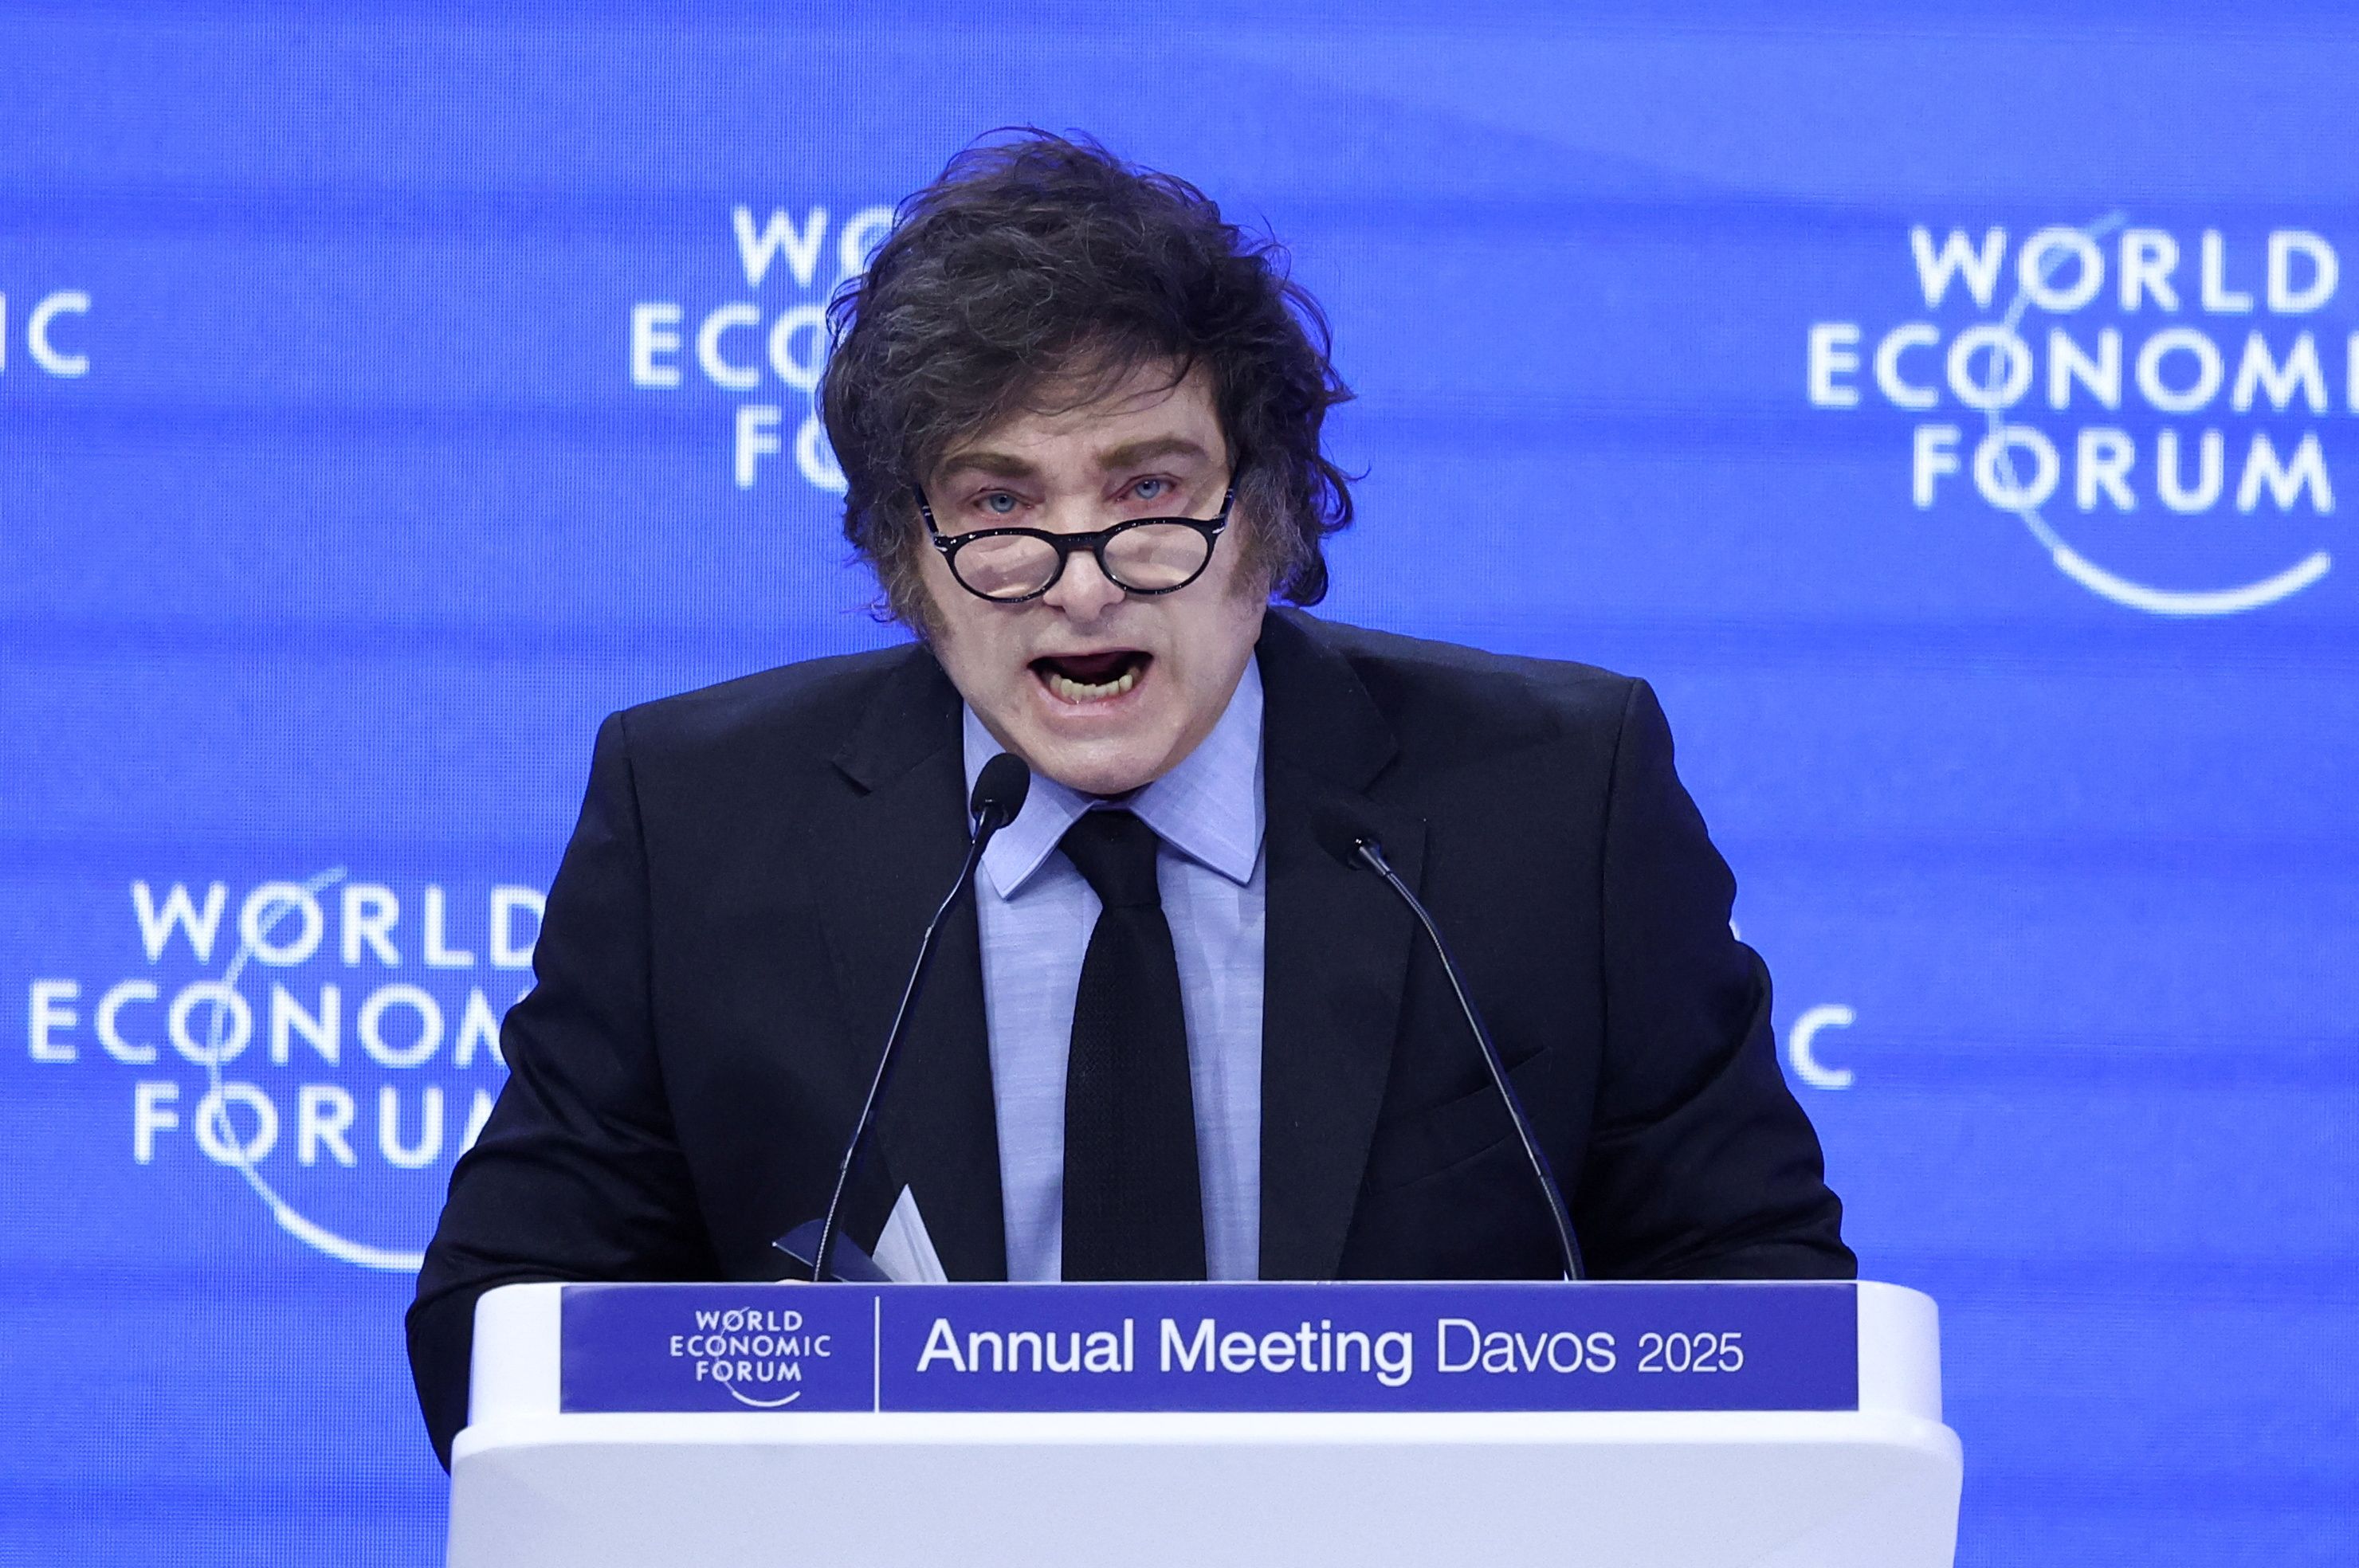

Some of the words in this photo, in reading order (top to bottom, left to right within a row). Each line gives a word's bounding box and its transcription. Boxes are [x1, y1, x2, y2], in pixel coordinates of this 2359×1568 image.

[1910, 226, 2340, 313] WORLD
[1912, 424, 2333, 514] FORUM
[132, 880, 547, 967] WORLD
[669, 1335, 831, 1357] ECONOMIC
[695, 1310, 803, 1332] WORLD
[917, 1318, 1134, 1374] Annual
[1160, 1318, 1413, 1386] Meeting
[1437, 1318, 1617, 1374] Davos
[1638, 1331, 1745, 1373] 2025
[695, 1360, 802, 1382] FORUM
